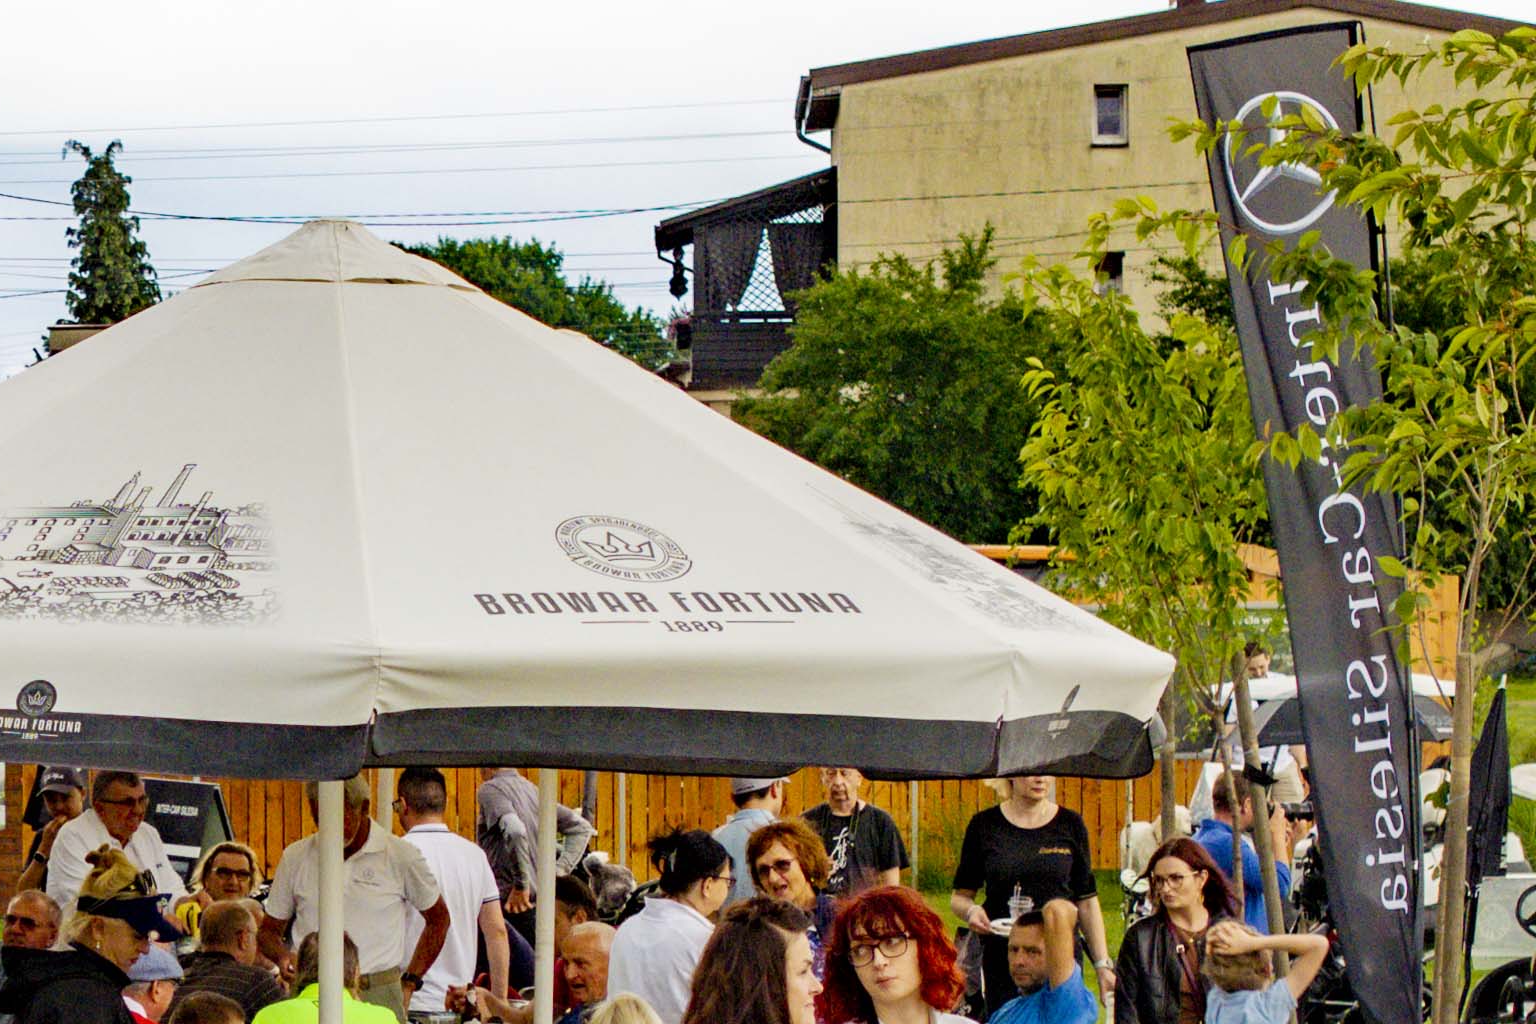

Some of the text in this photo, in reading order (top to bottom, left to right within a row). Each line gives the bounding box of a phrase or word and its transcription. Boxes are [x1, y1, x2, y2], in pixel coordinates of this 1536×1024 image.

[474, 591, 863, 615] BROWAR FORTUNA
[661, 619, 725, 633] 1889
[31, 718, 82, 733] FORTUNA
